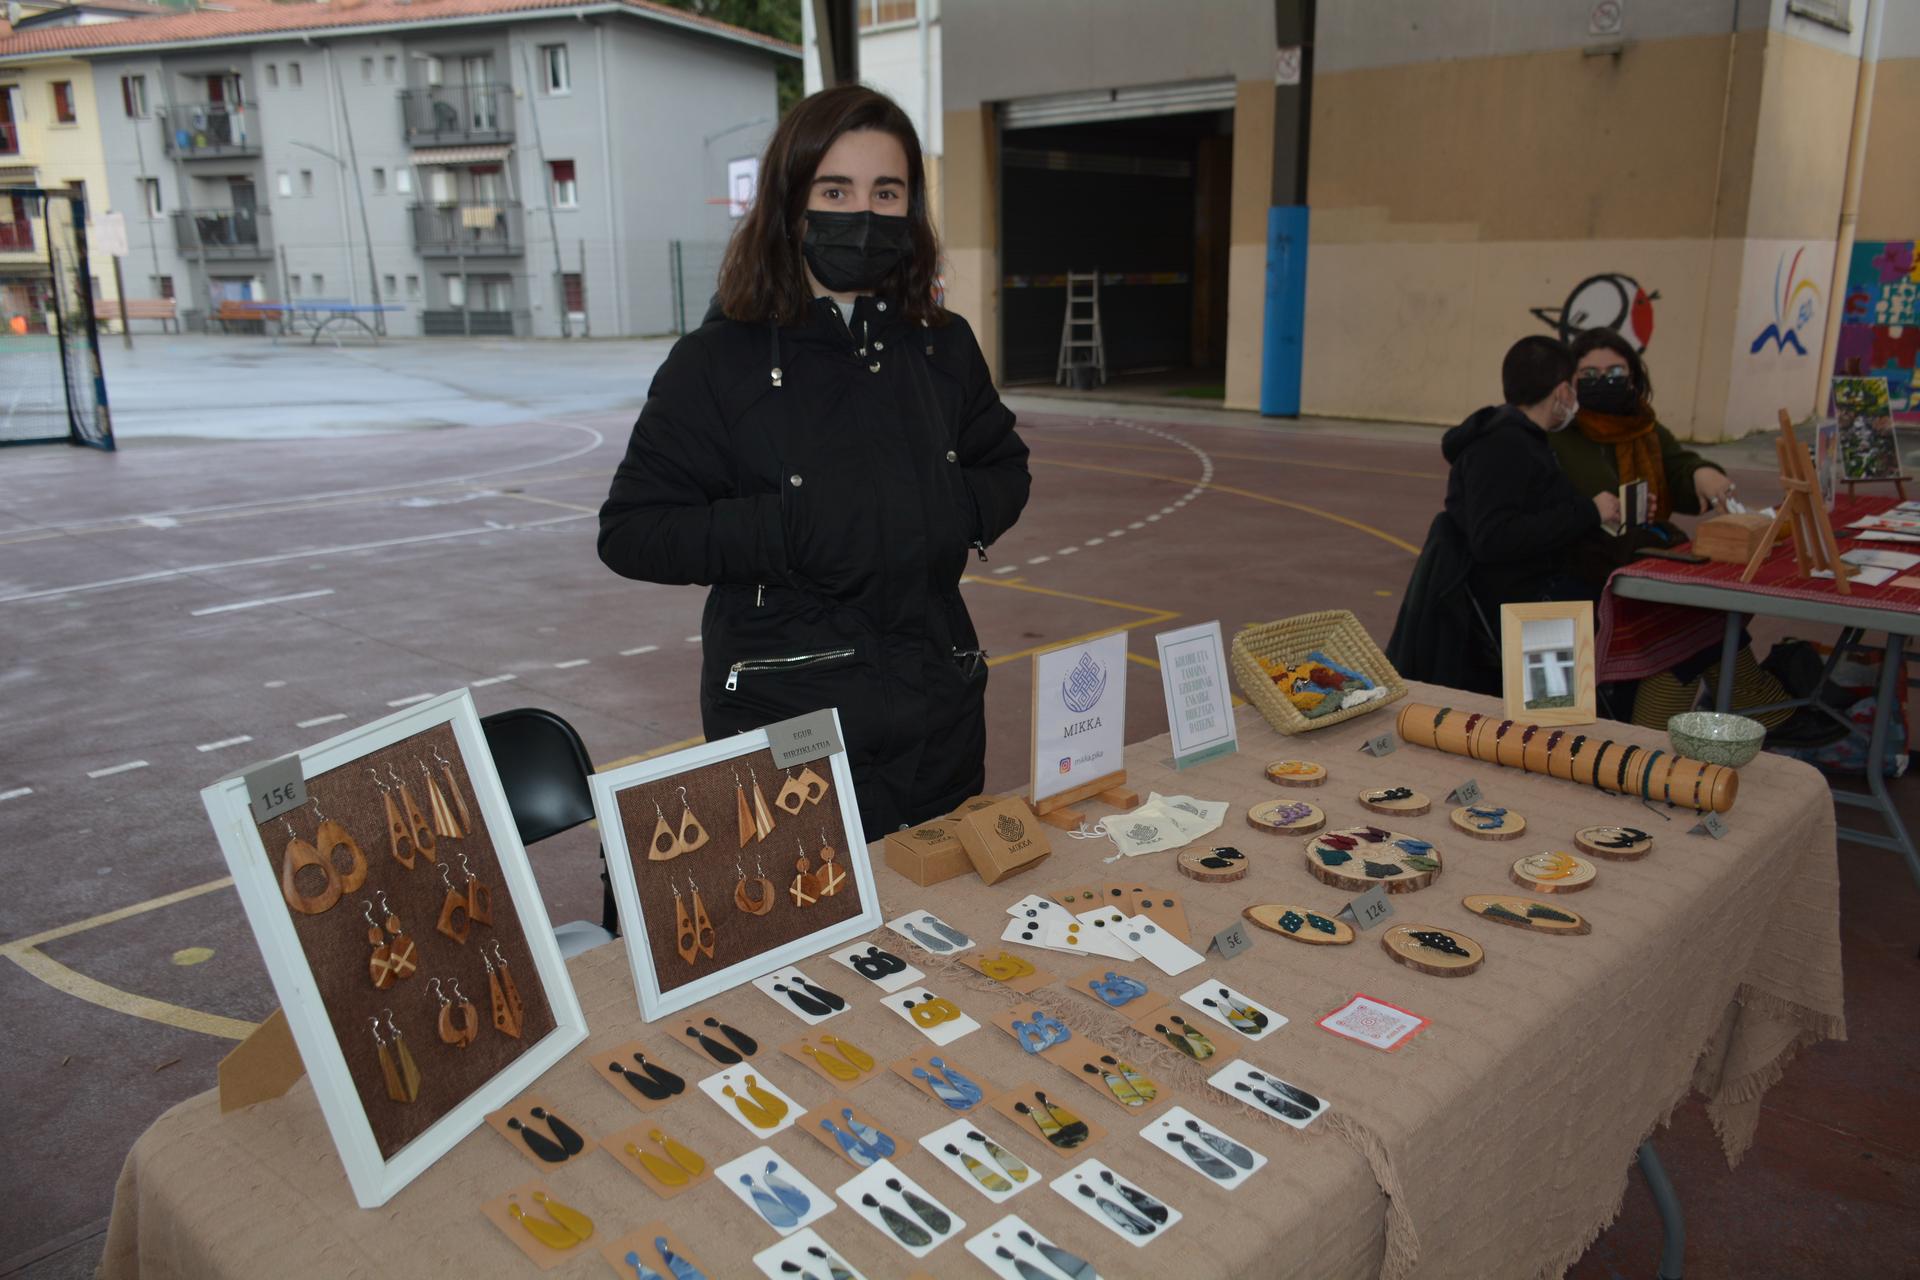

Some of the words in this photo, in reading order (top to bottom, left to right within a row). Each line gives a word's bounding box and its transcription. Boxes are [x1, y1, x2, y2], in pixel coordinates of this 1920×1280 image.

[793, 728, 813, 740] EGUR
[1063, 716, 1103, 739] MIKKA
[783, 740, 831, 760] BIRZIKLATUA
[262, 782, 296, 810] 15€
[1461, 784, 1478, 801] 15€
[1008, 839, 1033, 855] MIKKA
[1365, 900, 1386, 921] 12€
[1225, 932, 1242, 949] 5€
